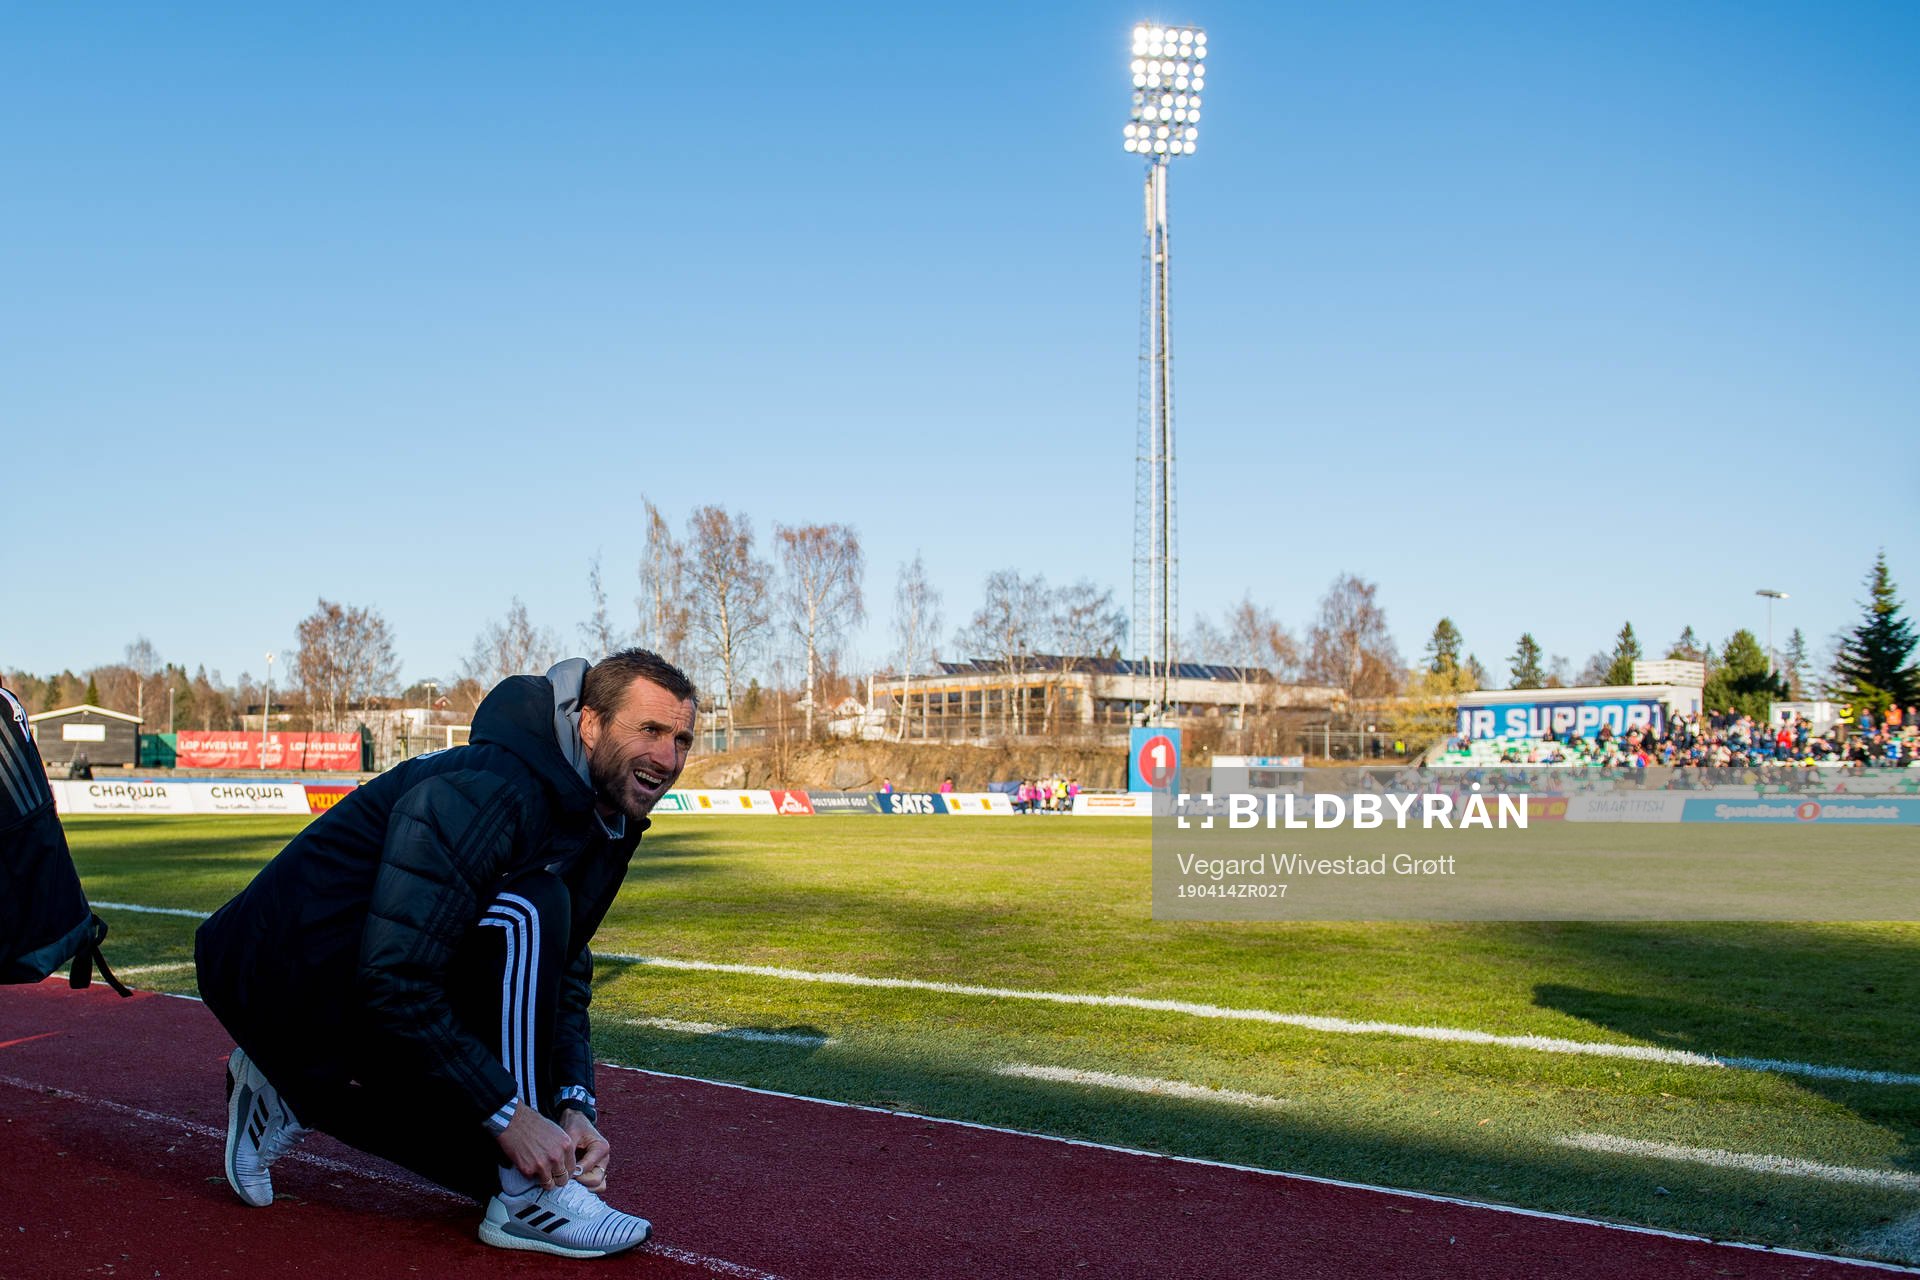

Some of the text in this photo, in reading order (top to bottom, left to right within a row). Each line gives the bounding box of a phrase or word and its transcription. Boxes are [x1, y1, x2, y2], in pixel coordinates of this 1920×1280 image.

[229, 741, 248, 750] UKE
[338, 742, 357, 751] UKE
[1151, 745, 1167, 779] 1
[89, 785, 167, 801] CHAQWA
[211, 786, 284, 802] CHAQWA
[890, 794, 935, 814] SATS
